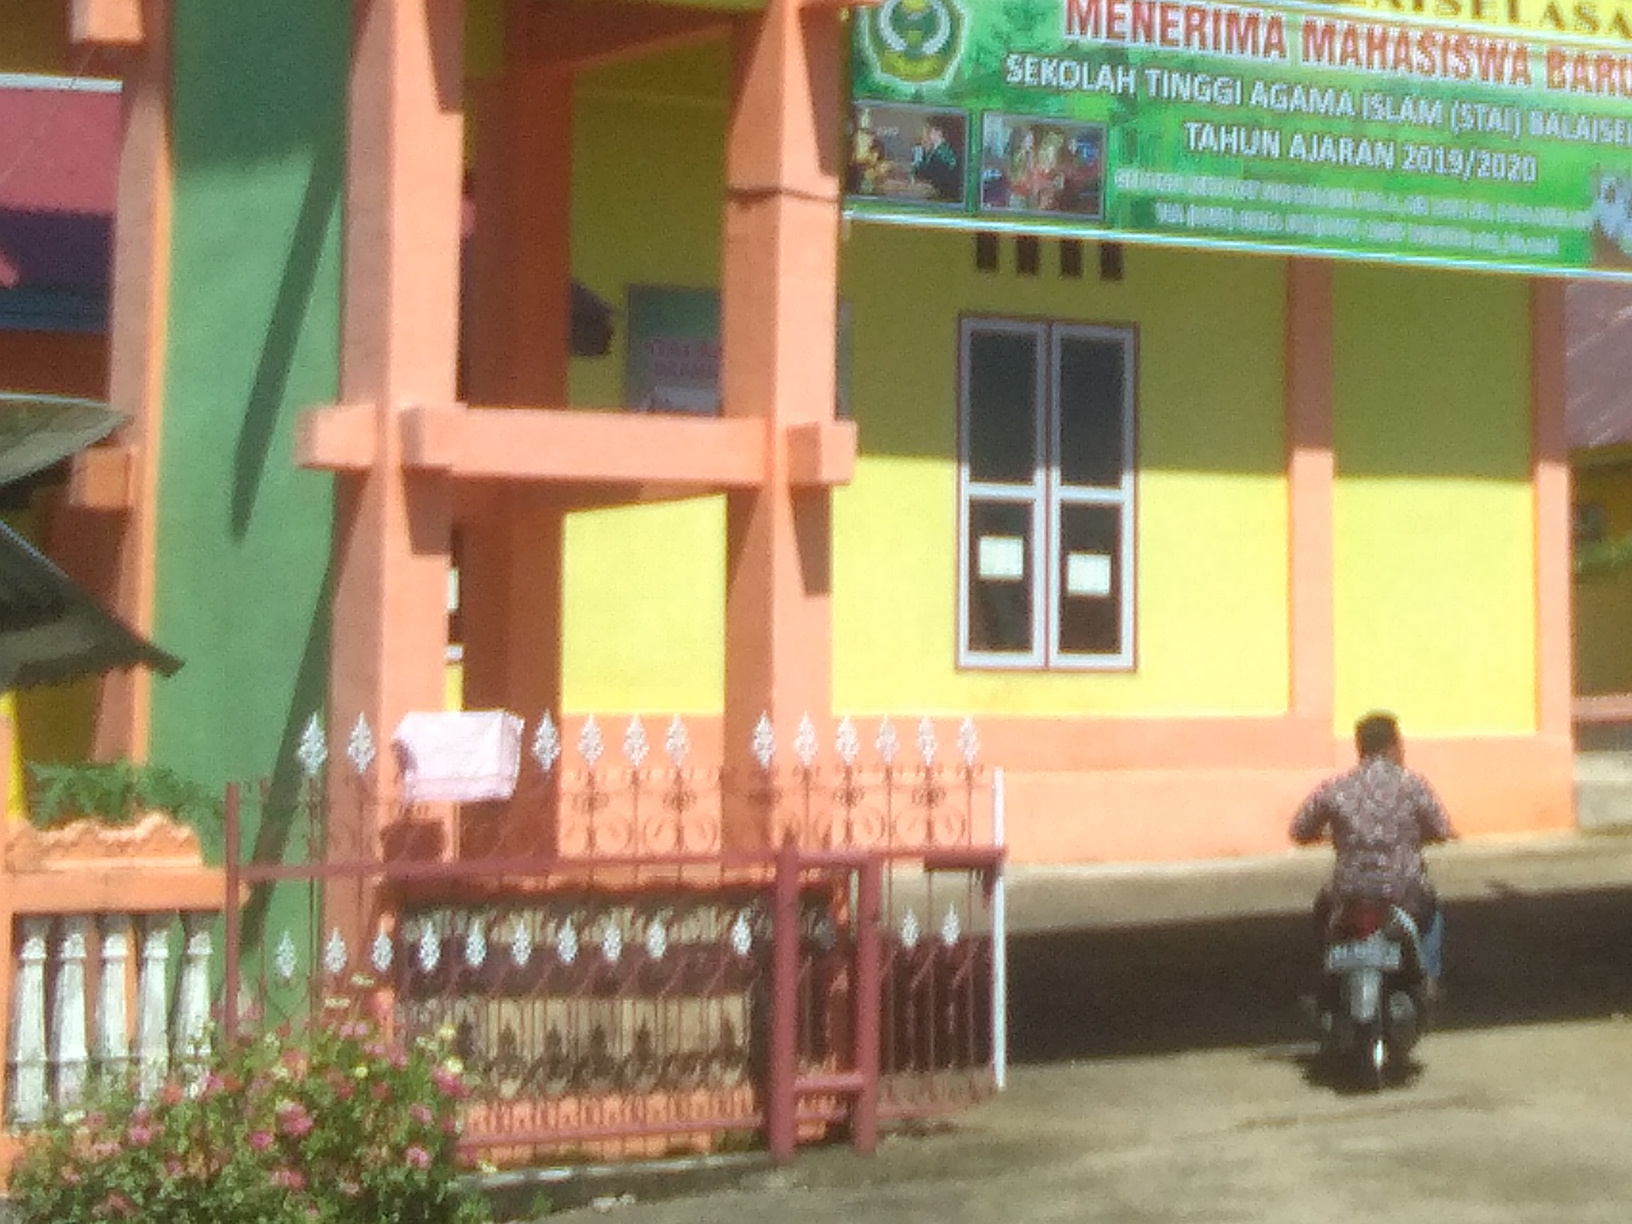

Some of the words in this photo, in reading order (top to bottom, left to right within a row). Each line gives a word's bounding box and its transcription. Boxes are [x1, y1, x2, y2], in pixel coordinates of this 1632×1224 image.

[1301, 16, 1533, 87] MAHASISWA
[1005, 53, 1137, 95] SEKOLAH
[1145, 68, 1242, 106] TINGGI
[1248, 79, 1355, 117] AGAMA
[1361, 92, 1443, 126] ISLAM
[1449, 99, 1522, 140] (STAI)
[1184, 121, 1281, 158] TAHUN
[1288, 132, 1396, 170] AJARAN
[1401, 143, 1539, 183] 2019/2020
